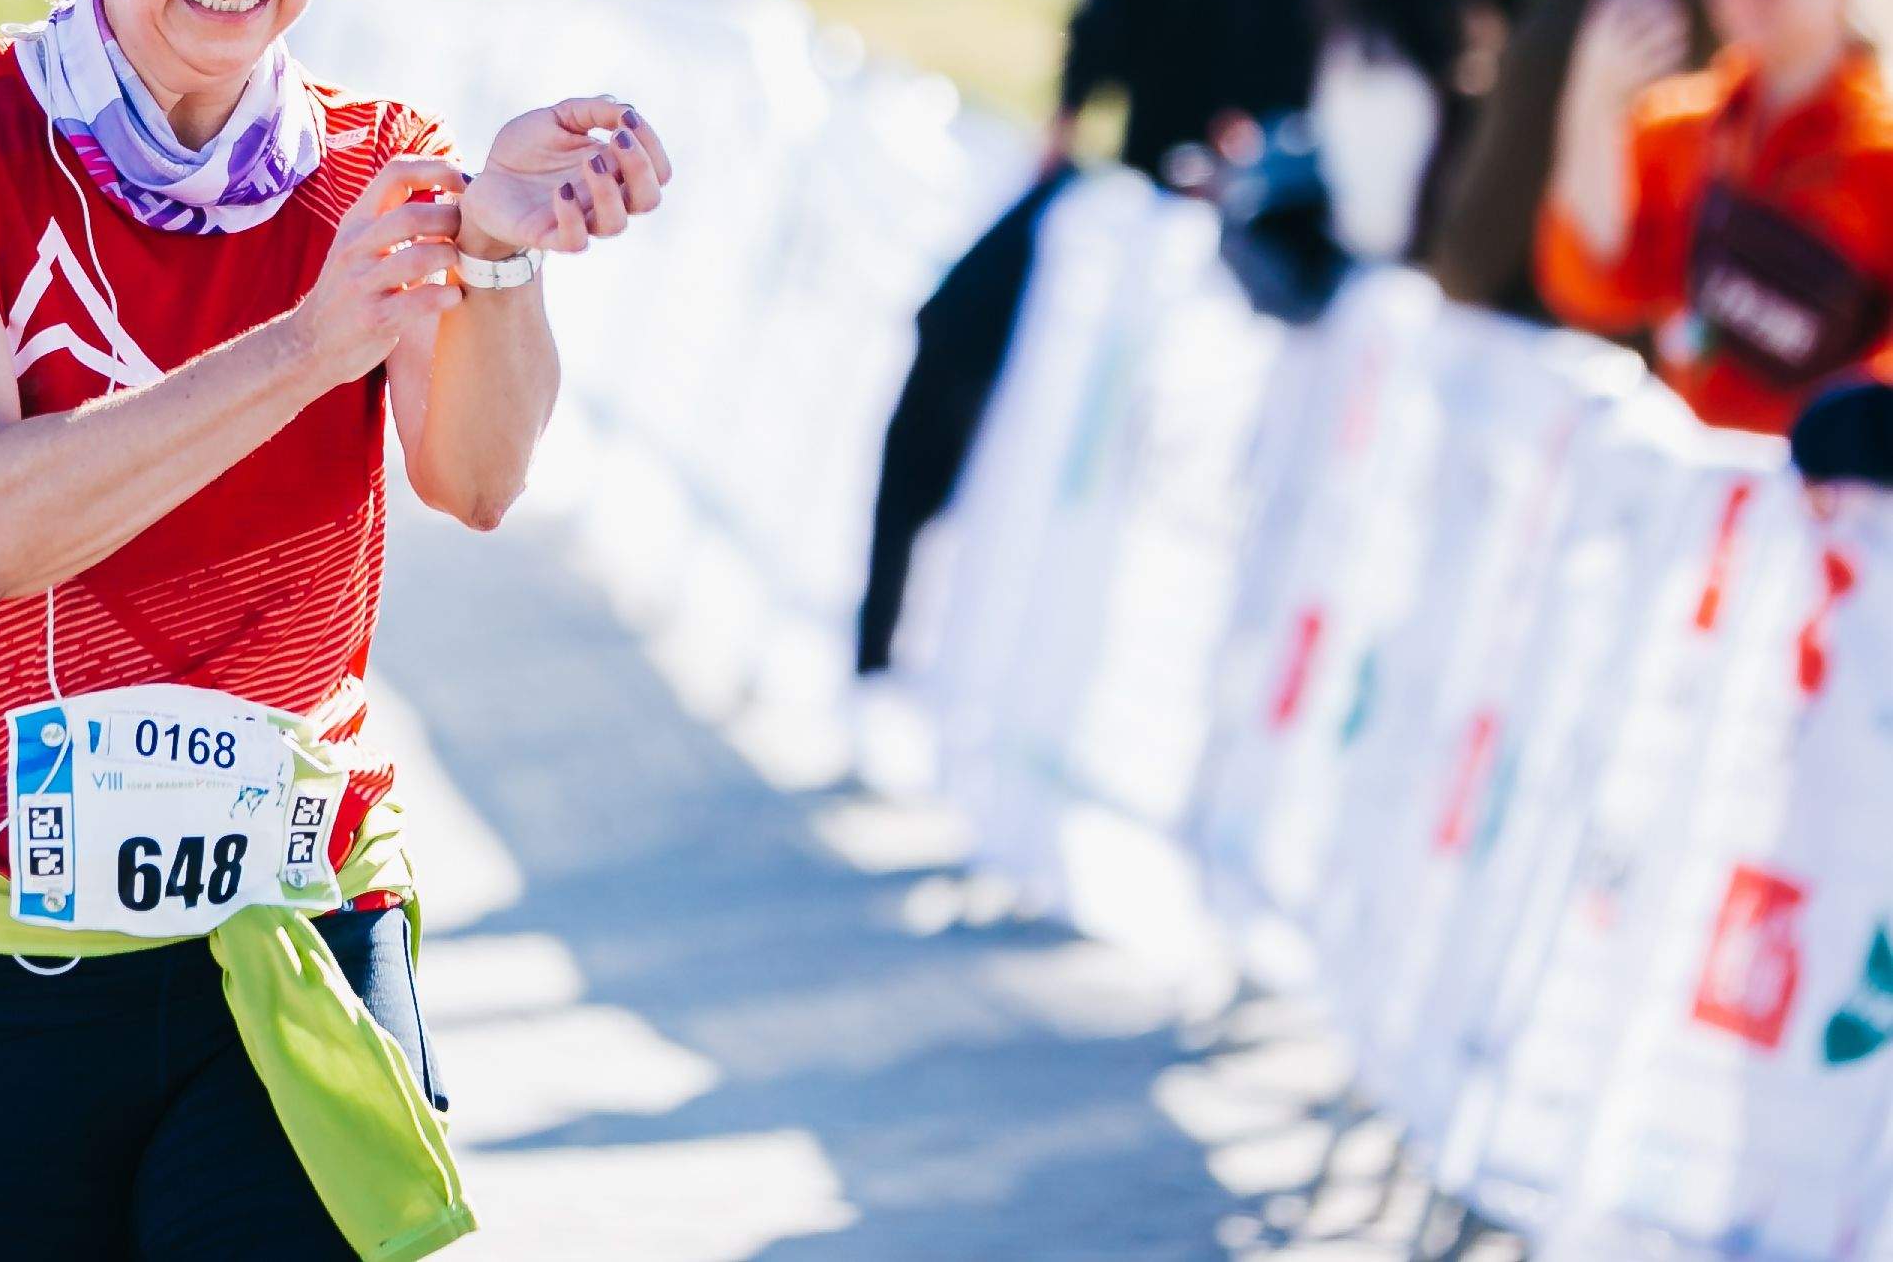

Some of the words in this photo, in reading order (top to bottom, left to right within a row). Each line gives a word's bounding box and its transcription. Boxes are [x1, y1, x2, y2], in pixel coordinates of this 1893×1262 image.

[134, 718, 236, 769] 0168
[91, 771, 124, 792] VIII
[116, 833, 249, 912] 648
